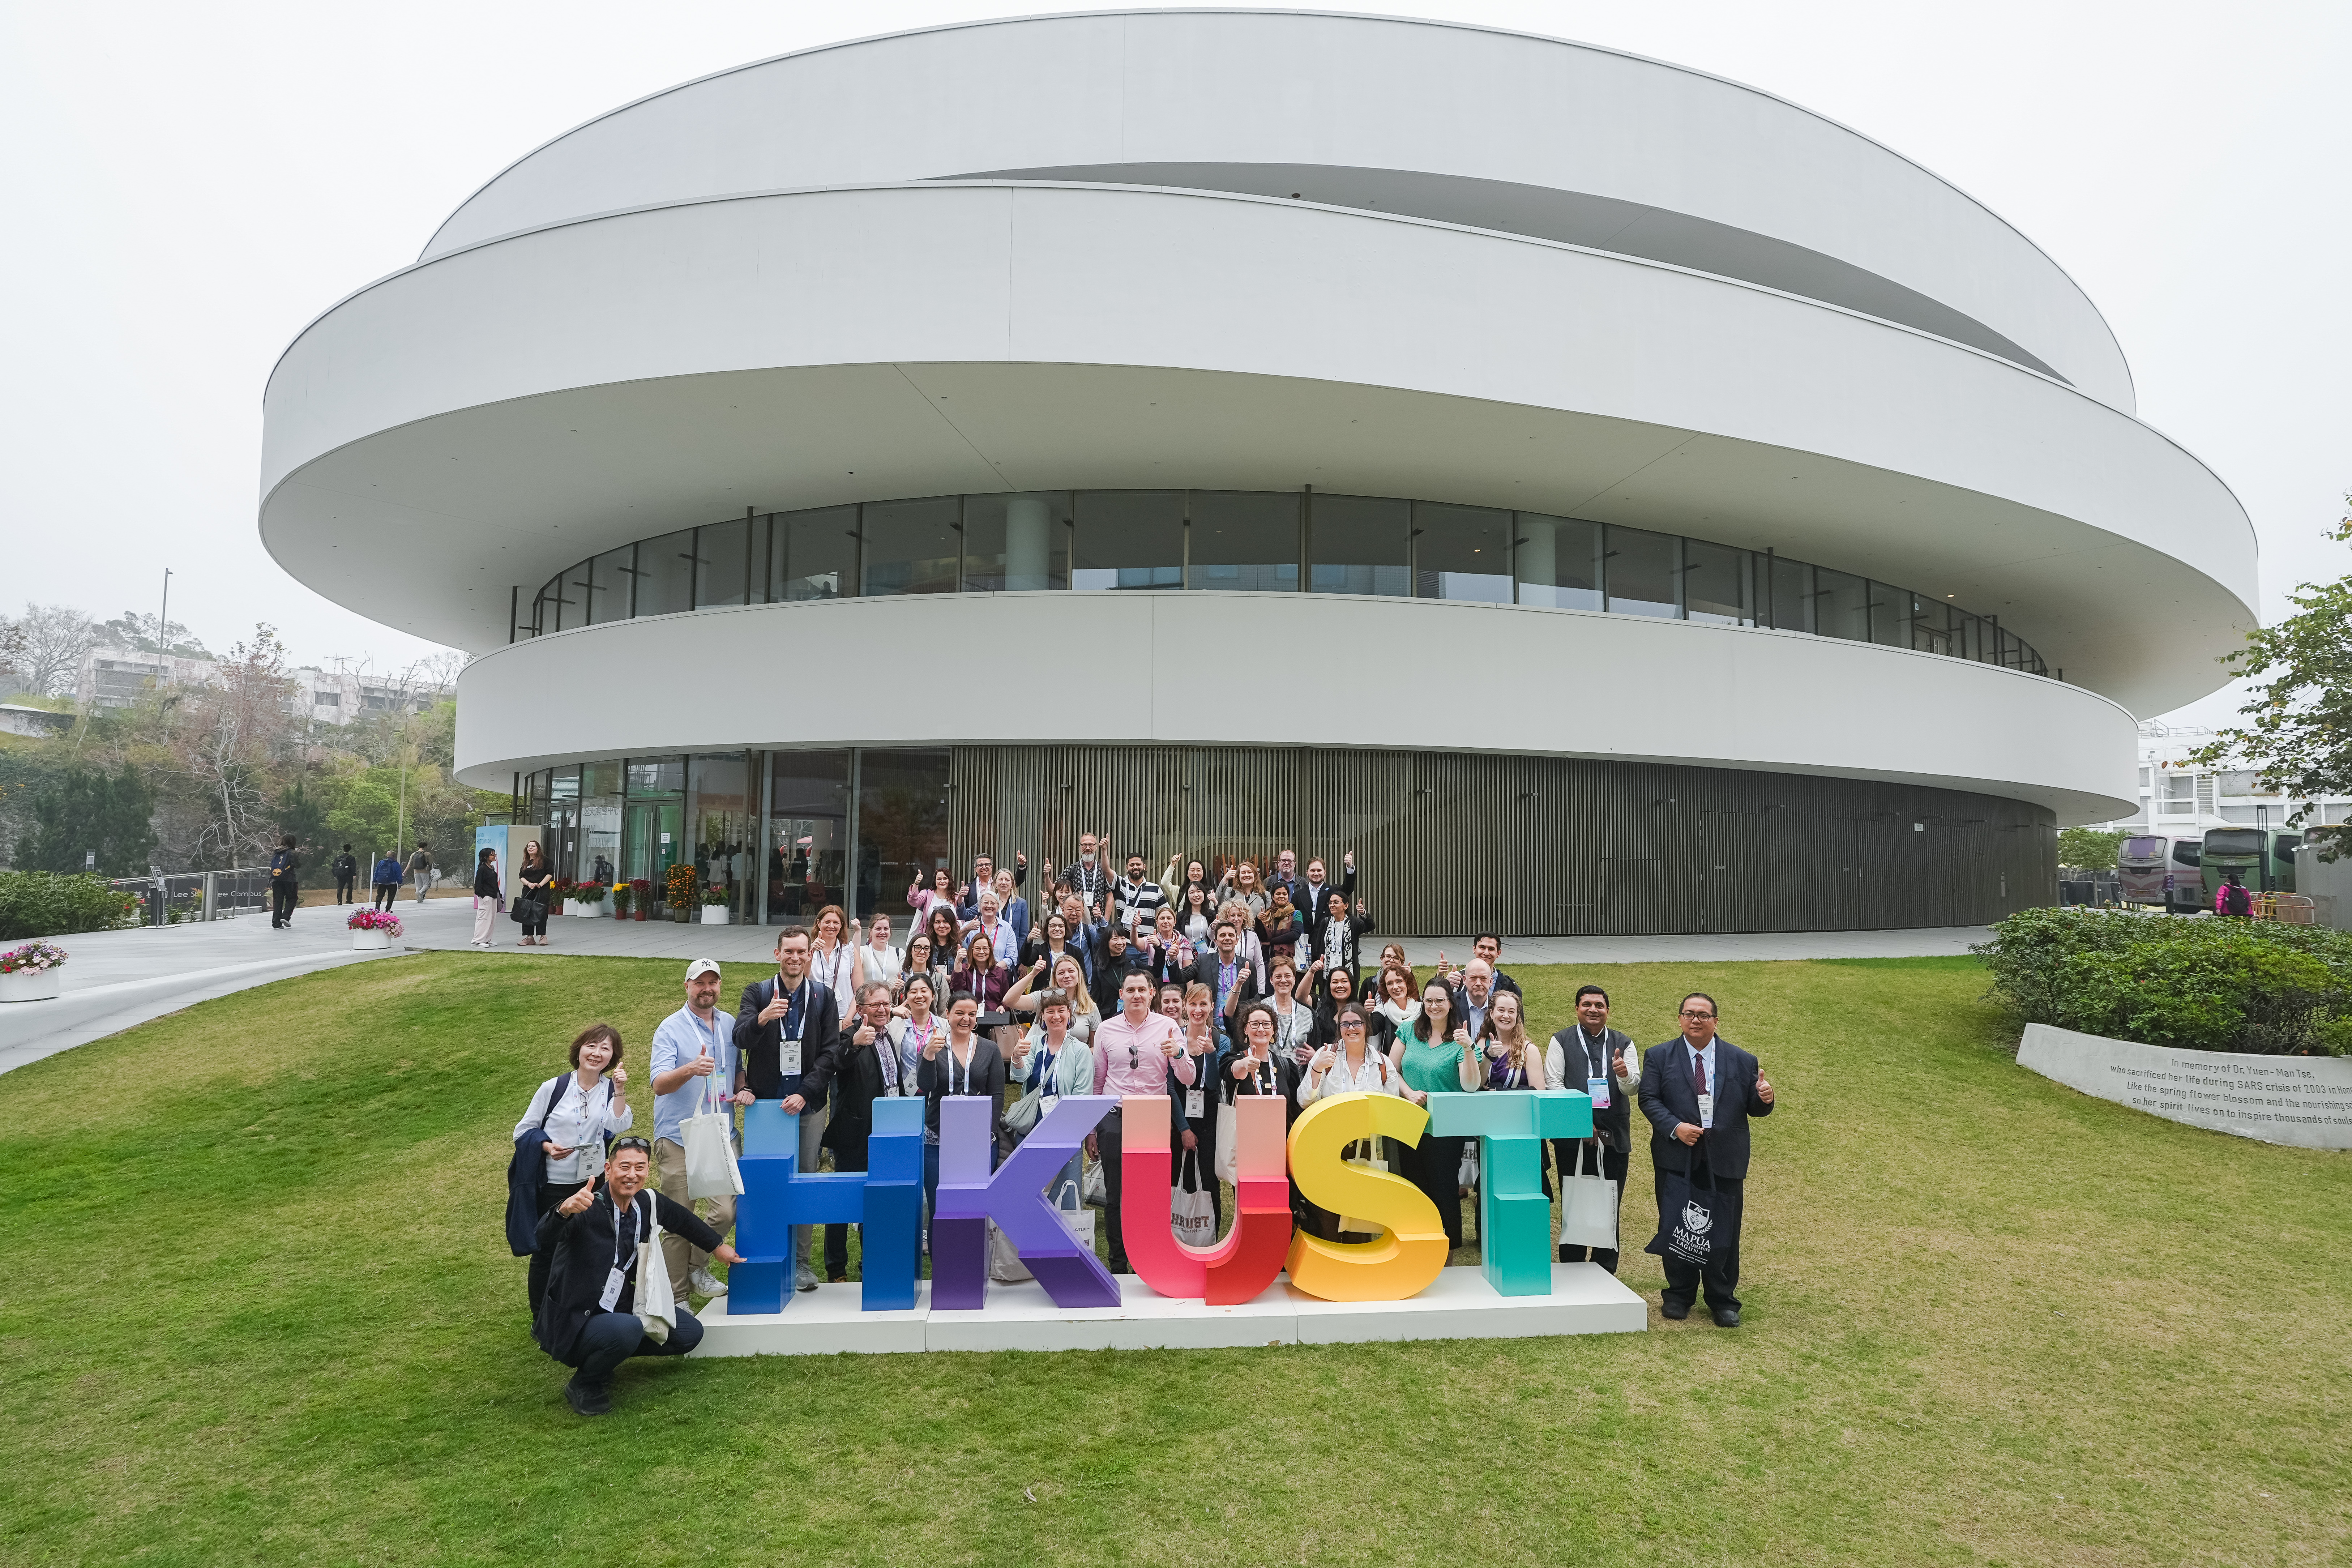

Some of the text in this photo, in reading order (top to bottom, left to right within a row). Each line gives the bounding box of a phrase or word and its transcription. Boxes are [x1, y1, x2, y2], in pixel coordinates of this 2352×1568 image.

[2111, 1065, 2126, 1074] who
[2127, 1068, 2166, 1080] sacrificed
[2169, 1073, 2182, 1082] her
[2186, 1075, 2200, 1084] life
[2203, 1077, 2234, 1090] during
[2237, 1080, 2263, 1090] SARS
[2266, 1084, 2291, 1092] crisis
[2293, 1084, 2301, 1093] of
[2304, 1085, 2326, 1093] 2003
[2328, 1086, 2337, 1094] in
[2182, 1061, 2219, 1073] memory
[2233, 1065, 2245, 1074] Dr.
[2127, 1081, 2142, 1090] Like
[2160, 1088, 2186, 1099] spring
[2190, 1090, 2220, 1101] flower
[2223, 1093, 2263, 1105] blossom
[2285, 1099, 2300, 1107] the
[2302, 1101, 2345, 1111] nourishing
[2143, 1098, 2157, 1106] her
[2160, 1102, 2183, 1111] spirit
[2188, 1103, 2210, 1114] lives
[2227, 1109, 2235, 1118] to
[2238, 1110, 2272, 1121] inspire
[2274, 1113, 2323, 1124] thousands
[2324, 1115, 2332, 1124] of
[727, 1091, 1592, 1315] HKUST
[1672, 1233, 1711, 1252] MALAYAN COLLEGES
[1673, 1226, 1711, 1249] MAPÚA
[1676, 1239, 1703, 1256] LAGUNA
